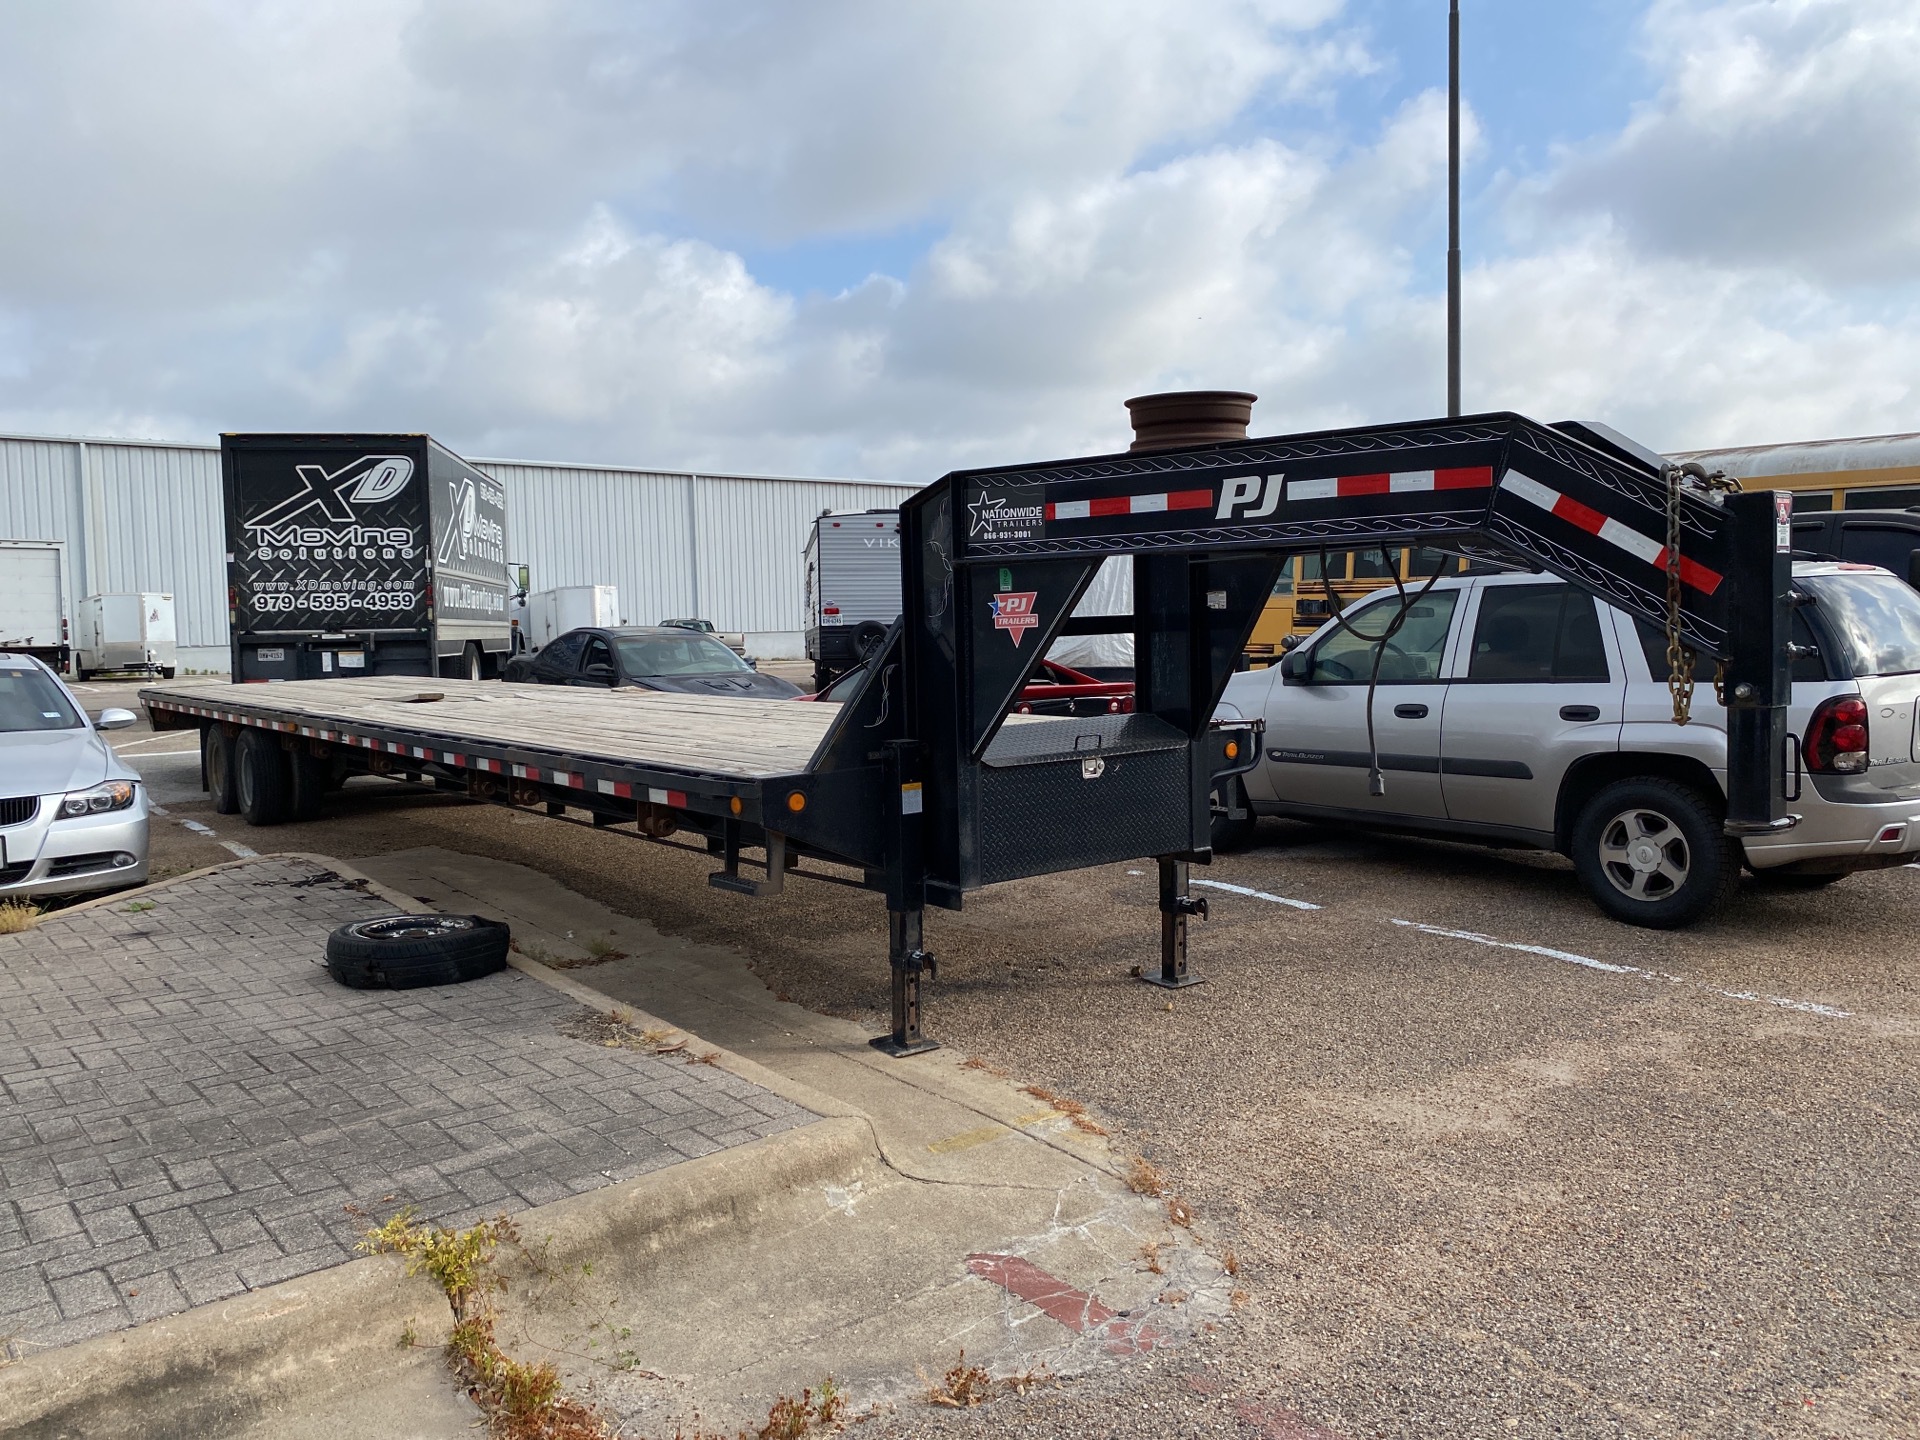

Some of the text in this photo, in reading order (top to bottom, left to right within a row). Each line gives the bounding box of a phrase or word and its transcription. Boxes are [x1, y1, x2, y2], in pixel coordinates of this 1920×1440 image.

[244, 455, 414, 528] XD
[1215, 473, 1285, 520] PJ
[982, 506, 1043, 519] NATIONWIDE
[438, 478, 475, 564] XD
[996, 519, 1043, 528] TRAILERS
[257, 525, 413, 547] Moving
[257, 547, 414, 560] Solutions
[253, 578, 415, 592] www.XDmoving.com
[1005, 597, 1028, 612] PJ
[998, 616, 1036, 626] TRAILERS
